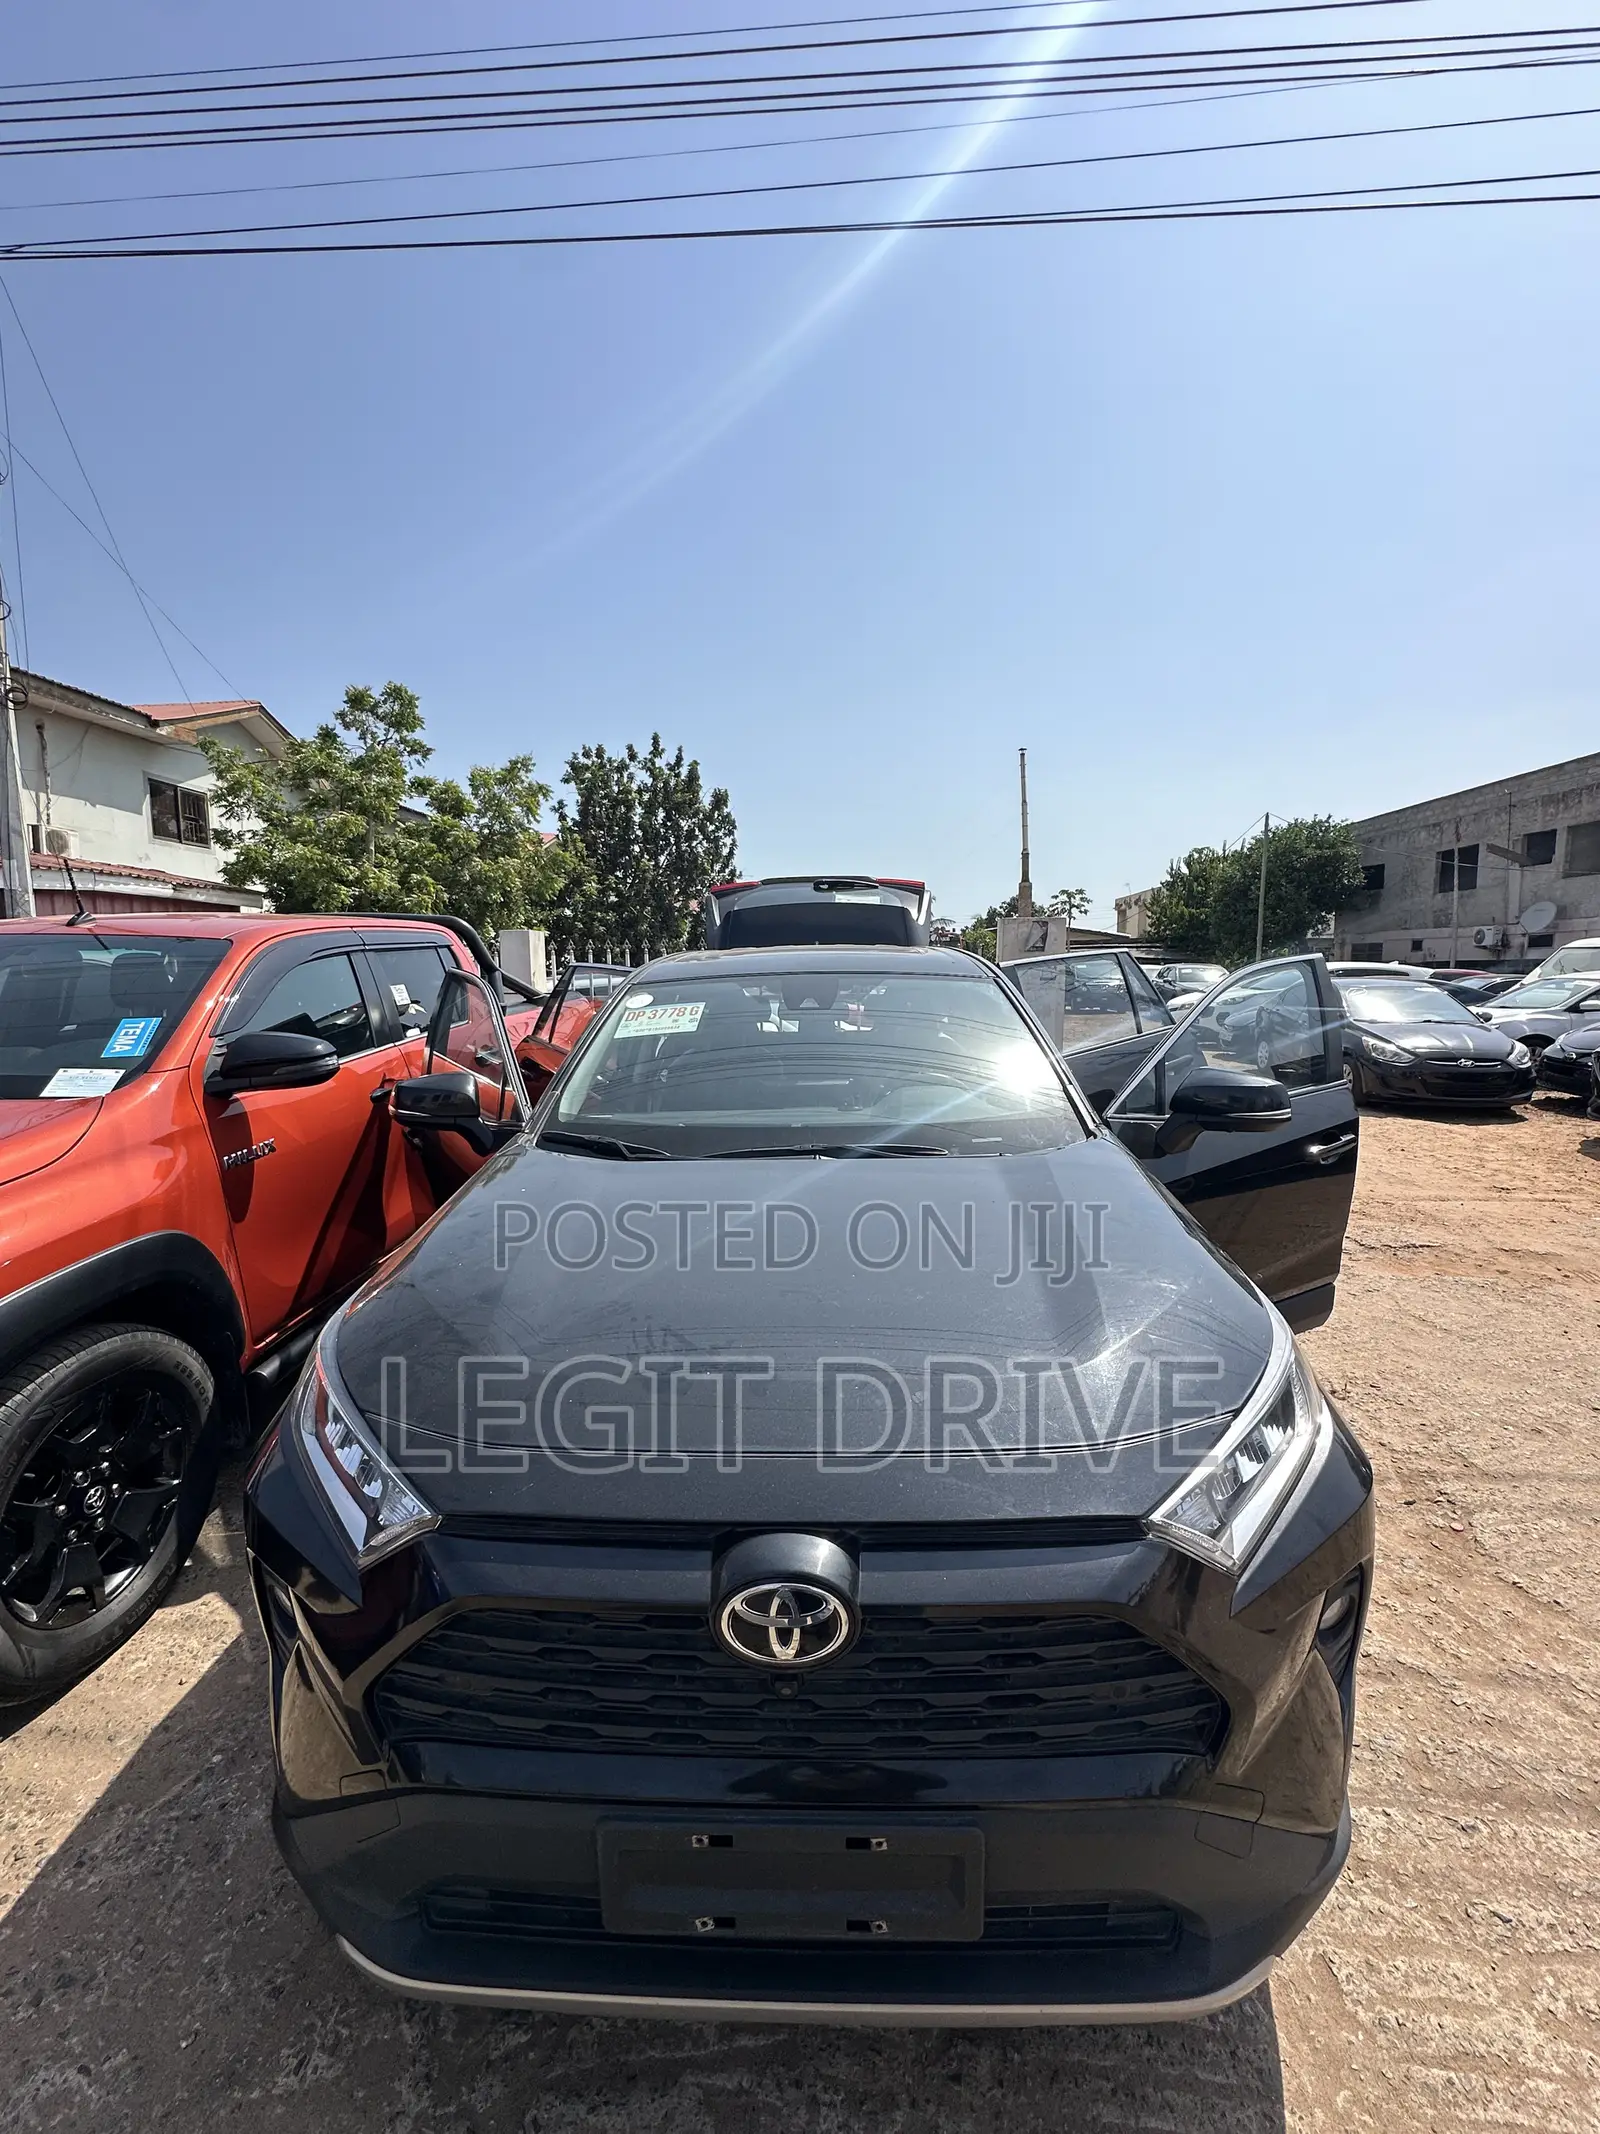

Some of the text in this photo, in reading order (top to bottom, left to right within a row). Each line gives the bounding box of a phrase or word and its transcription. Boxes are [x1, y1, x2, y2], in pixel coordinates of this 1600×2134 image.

[625, 1005, 700, 1022] DP 3778 G
[110, 1021, 145, 1053] TEMA
[223, 1137, 276, 1170] HILUX
